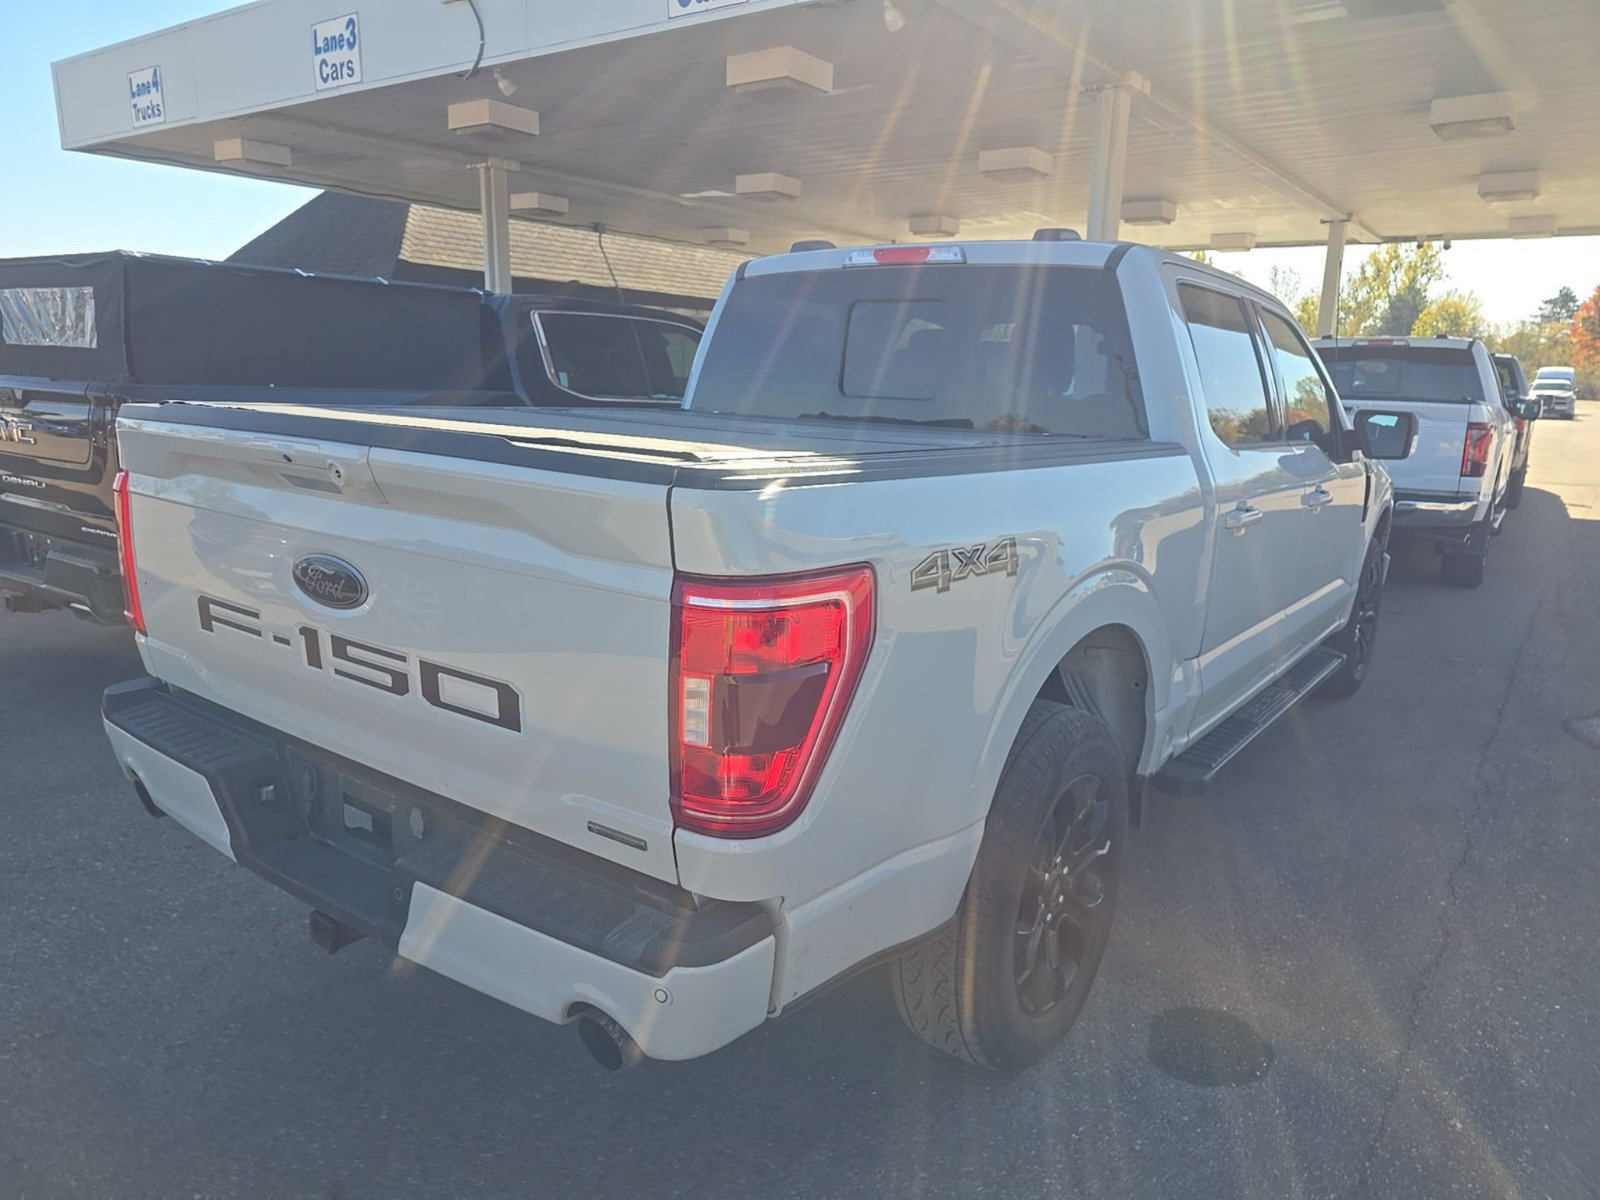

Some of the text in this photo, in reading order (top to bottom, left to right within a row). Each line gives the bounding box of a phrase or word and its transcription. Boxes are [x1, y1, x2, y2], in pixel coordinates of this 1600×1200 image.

[319, 58, 355, 84] Cars
[132, 99, 162, 122] Trucks
[1, 474, 47, 489] DENALI
[296, 564, 357, 599] Ford
[197, 594, 522, 734] F-150
